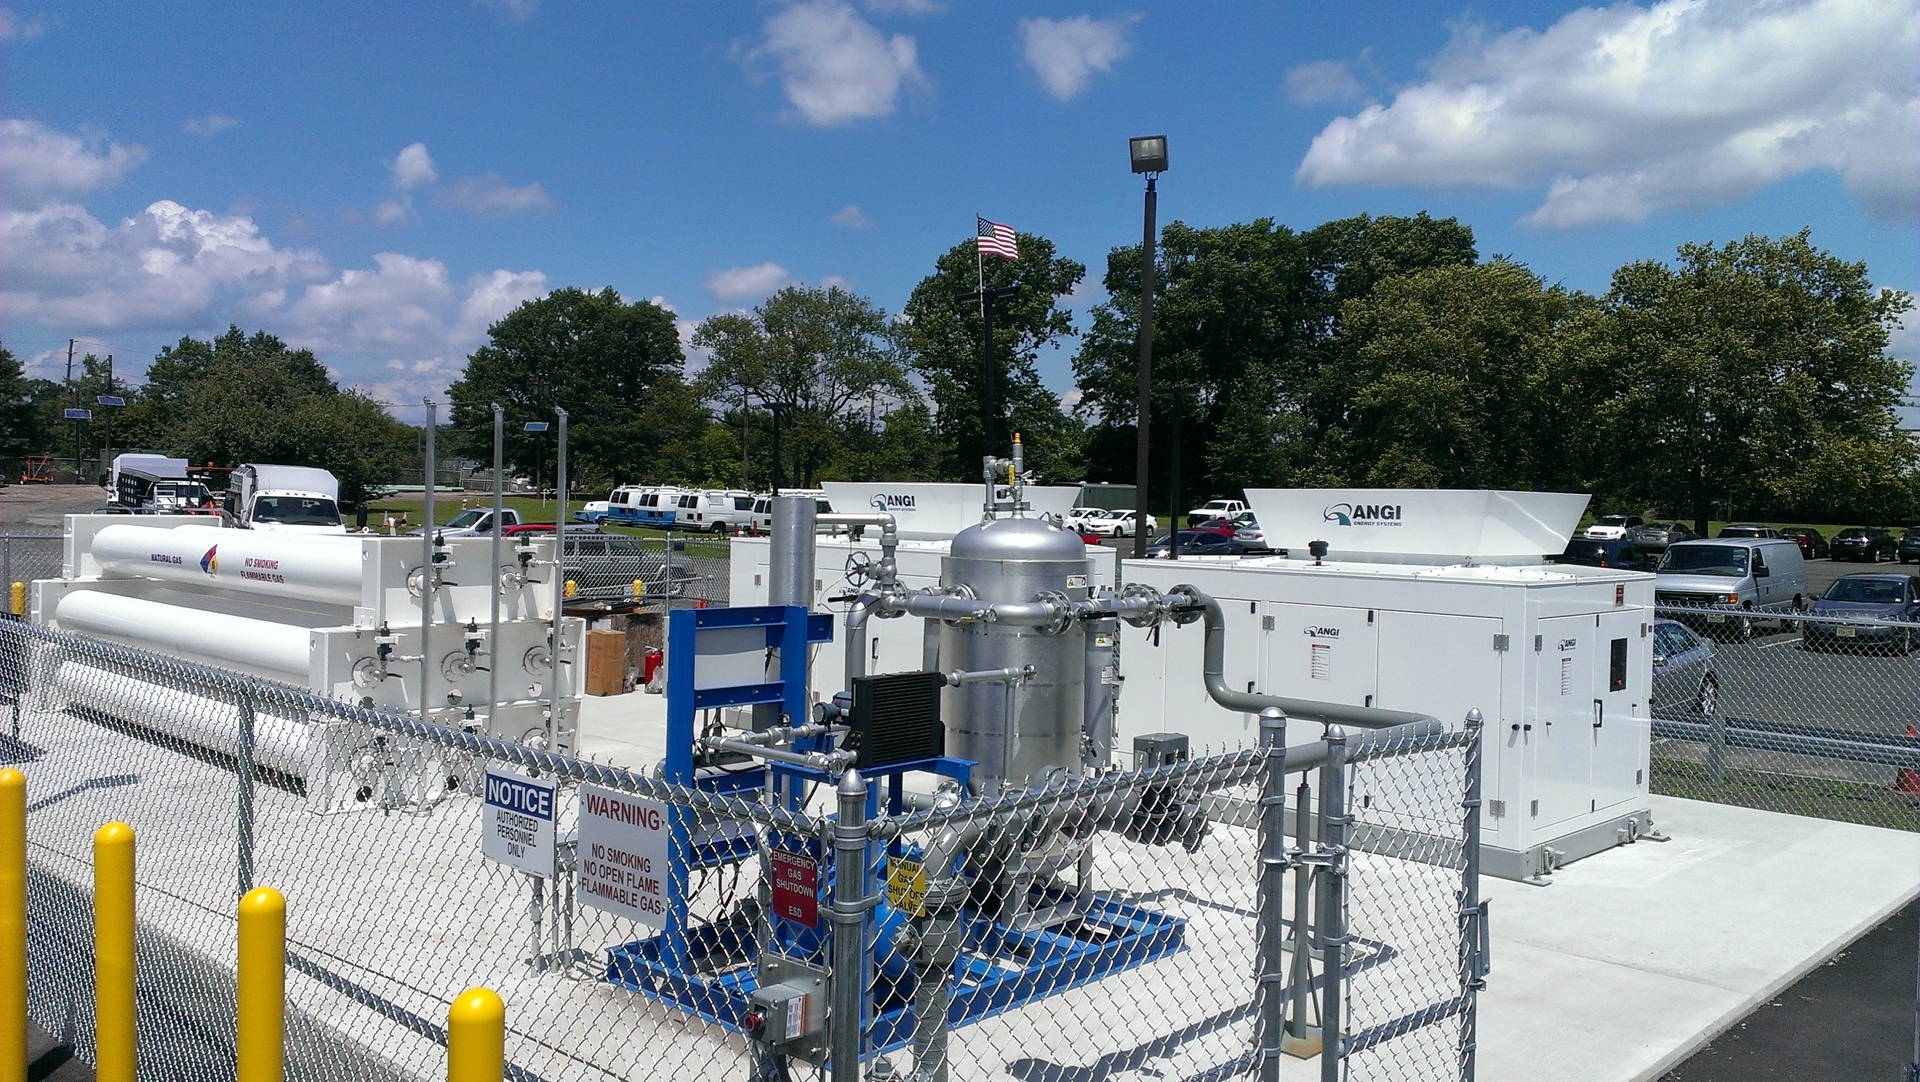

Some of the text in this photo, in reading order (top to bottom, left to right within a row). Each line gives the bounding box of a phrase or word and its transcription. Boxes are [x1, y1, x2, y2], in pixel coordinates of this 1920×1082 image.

[887, 494, 915, 507] ANGI
[1352, 505, 1401, 520] ANGI
[151, 553, 182, 565] NATURAL GAS
[244, 557, 279, 570] NO SMOKING
[240, 570, 284, 584] FLAMMABLE GAS
[1317, 627, 1340, 636] ANGI
[488, 778, 549, 816] NOTICE
[586, 793, 660, 831] WARNING
[496, 809, 539, 833] AUTHORIZED
[497, 824, 537, 848] PERSONNEL
[507, 842, 526, 859] ONLY
[591, 843, 651, 873] NO SMOKING
[773, 851, 815, 871] EMERGENCY
[583, 859, 660, 896] NO OPEN FLAME
[787, 868, 802, 880] GAS
[898, 873, 914, 886] GAS
[581, 877, 661, 915] FLAMMABLE GAS
[776, 878, 814, 898] SHUTDOWN
[788, 905, 803, 918] ESD
